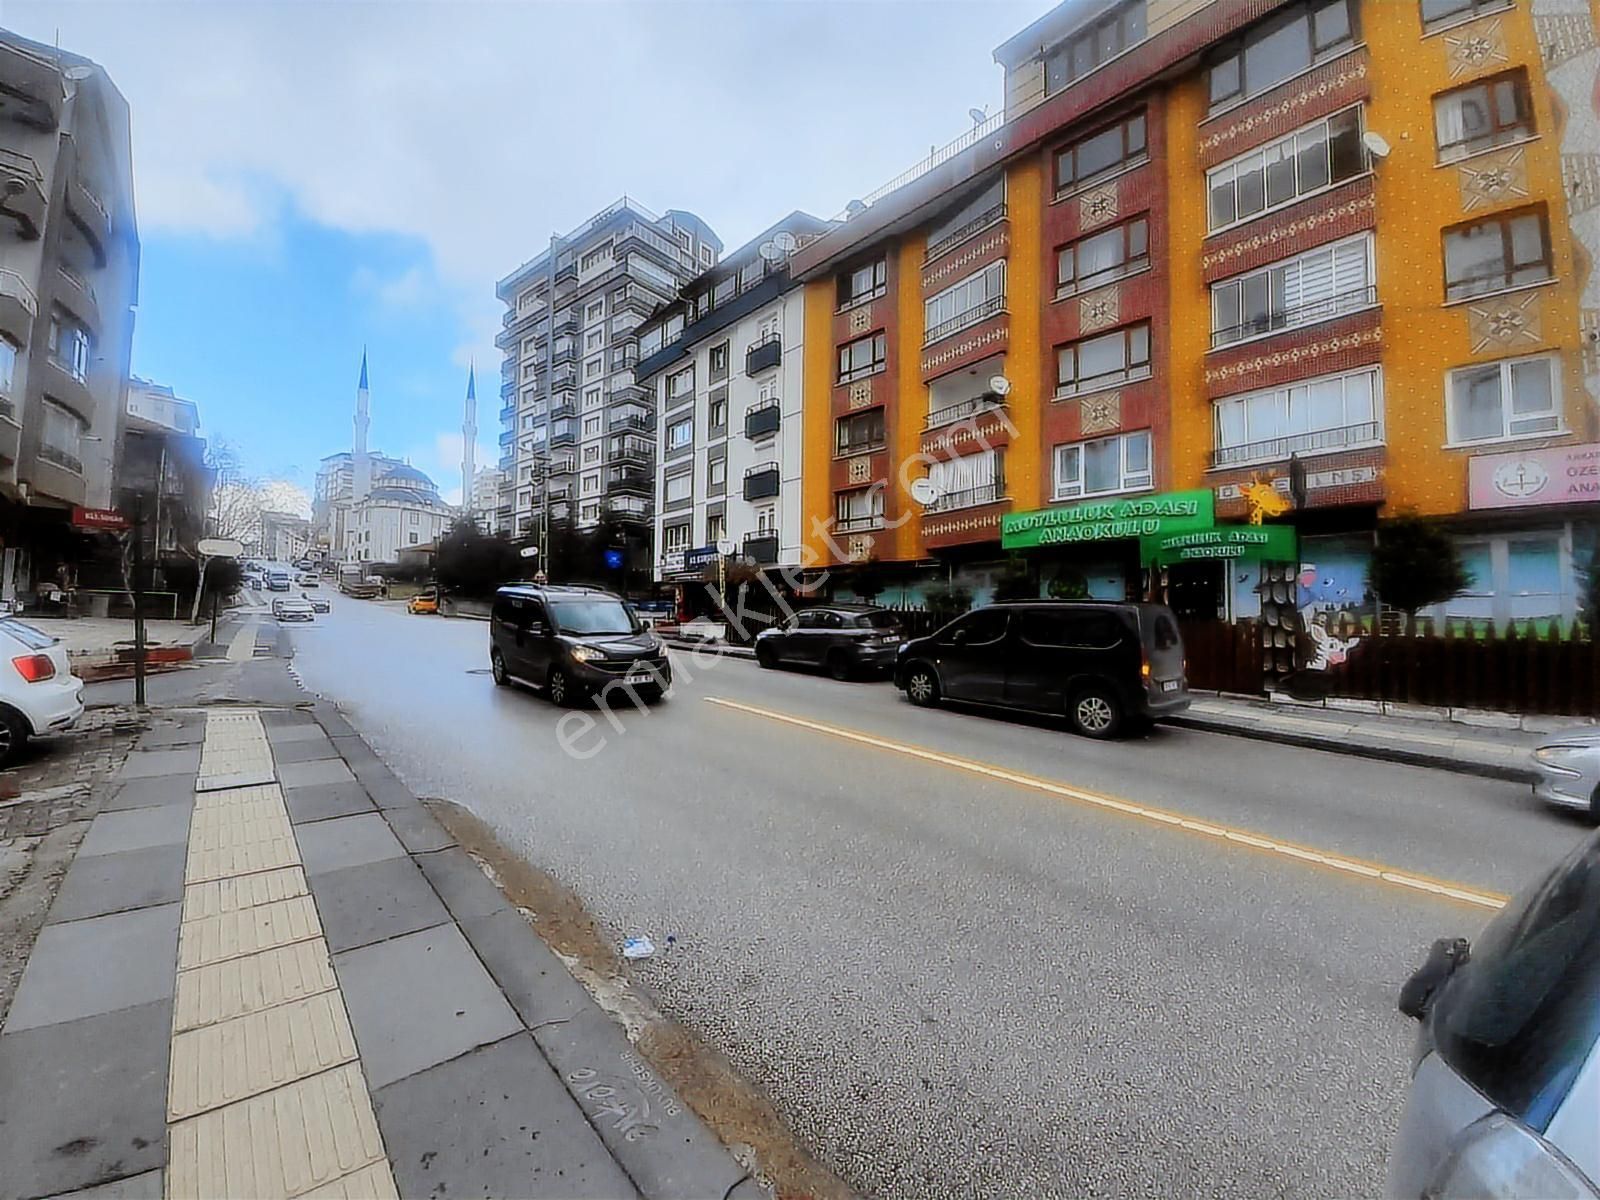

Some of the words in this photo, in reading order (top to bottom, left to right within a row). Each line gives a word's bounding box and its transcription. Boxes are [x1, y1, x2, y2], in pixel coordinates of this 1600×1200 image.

[1005, 504, 1115, 533] MUTLULUK
[1120, 500, 1198, 517] ADASI
[1039, 519, 1160, 543] ANAOKULU
